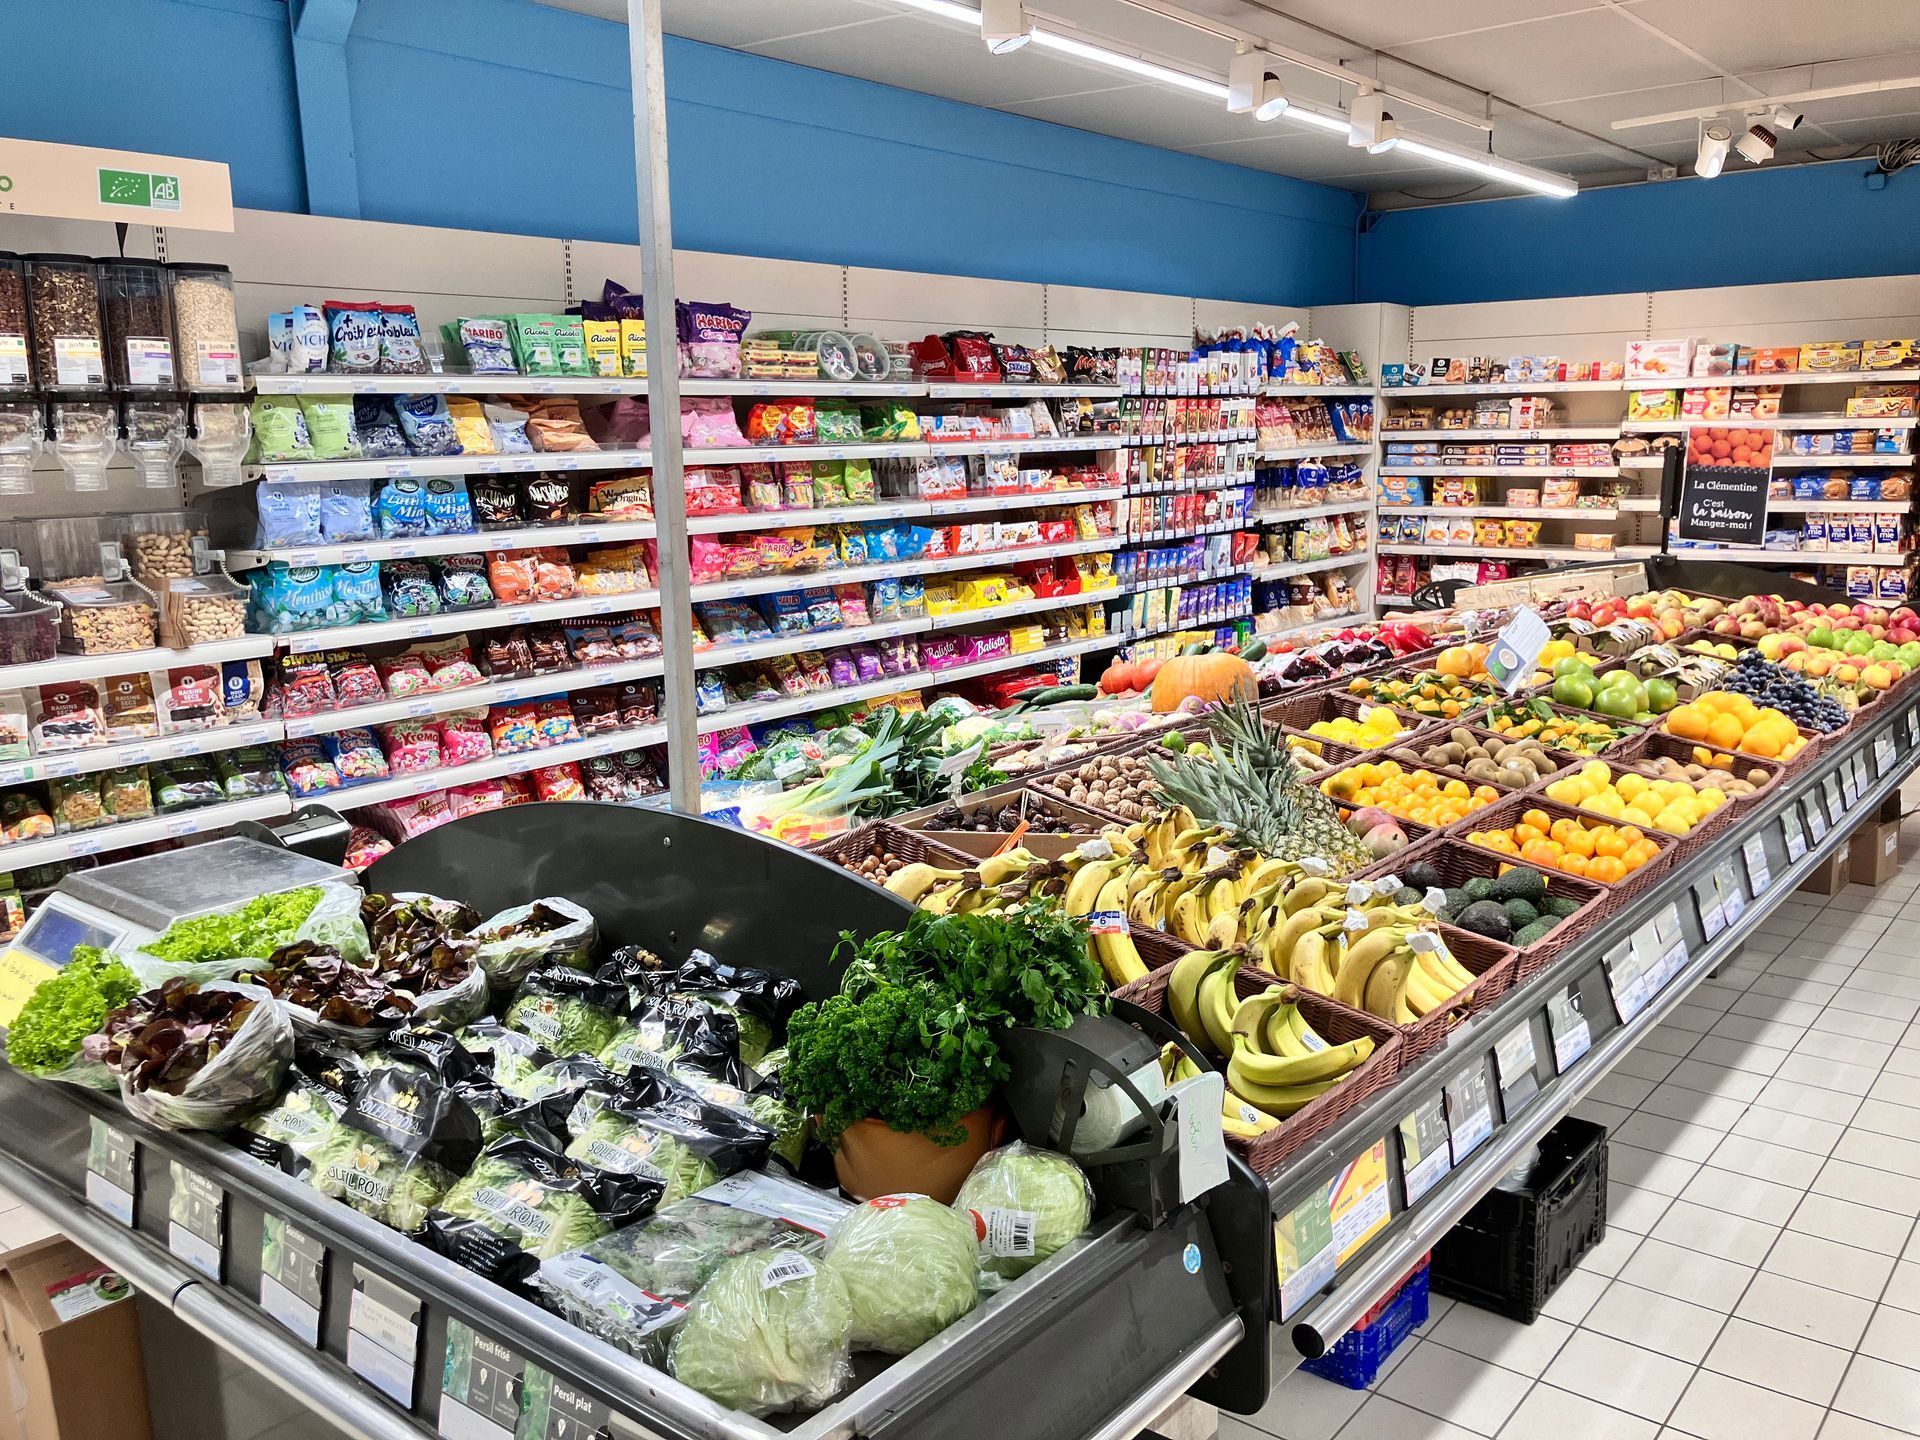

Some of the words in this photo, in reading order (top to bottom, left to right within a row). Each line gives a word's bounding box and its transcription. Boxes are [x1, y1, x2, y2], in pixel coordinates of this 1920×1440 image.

[154, 182, 175, 199] AB
[696, 313, 742, 331] HARIBO
[465, 327, 503, 340] HARIBO
[524, 327, 550, 336] Ricola
[554, 328, 580, 337] Ricola
[591, 334, 616, 343] Ricola
[1866, 354, 1898, 363] Savane
[1694, 480, 1704, 489] La
[1707, 481, 1758, 492] Clémentine
[1703, 499, 1724, 507] C'est
[1693, 503, 1708, 516] la
[1711, 508, 1753, 520] saison
[1691, 518, 1747, 529] Mangez-moi
[804, 587, 831, 598] HARIBO
[927, 642, 954, 659] Balisto
[977, 636, 1005, 655] Balisto
[232, 679, 239, 687] U
[400, 731, 438, 745] Krema
[388, 1030, 416, 1048] SOLEIL
[356, 1174, 390, 1206] ROYAL
[1341, 1195, 1353, 1208] BANANE
[509, 1201, 554, 1236] ROYAL
[474, 1336, 494, 1354] Persil
[495, 1345, 511, 1362] frisé
[554, 1384, 575, 1405] Persil
[575, 1394, 592, 1414] plat
